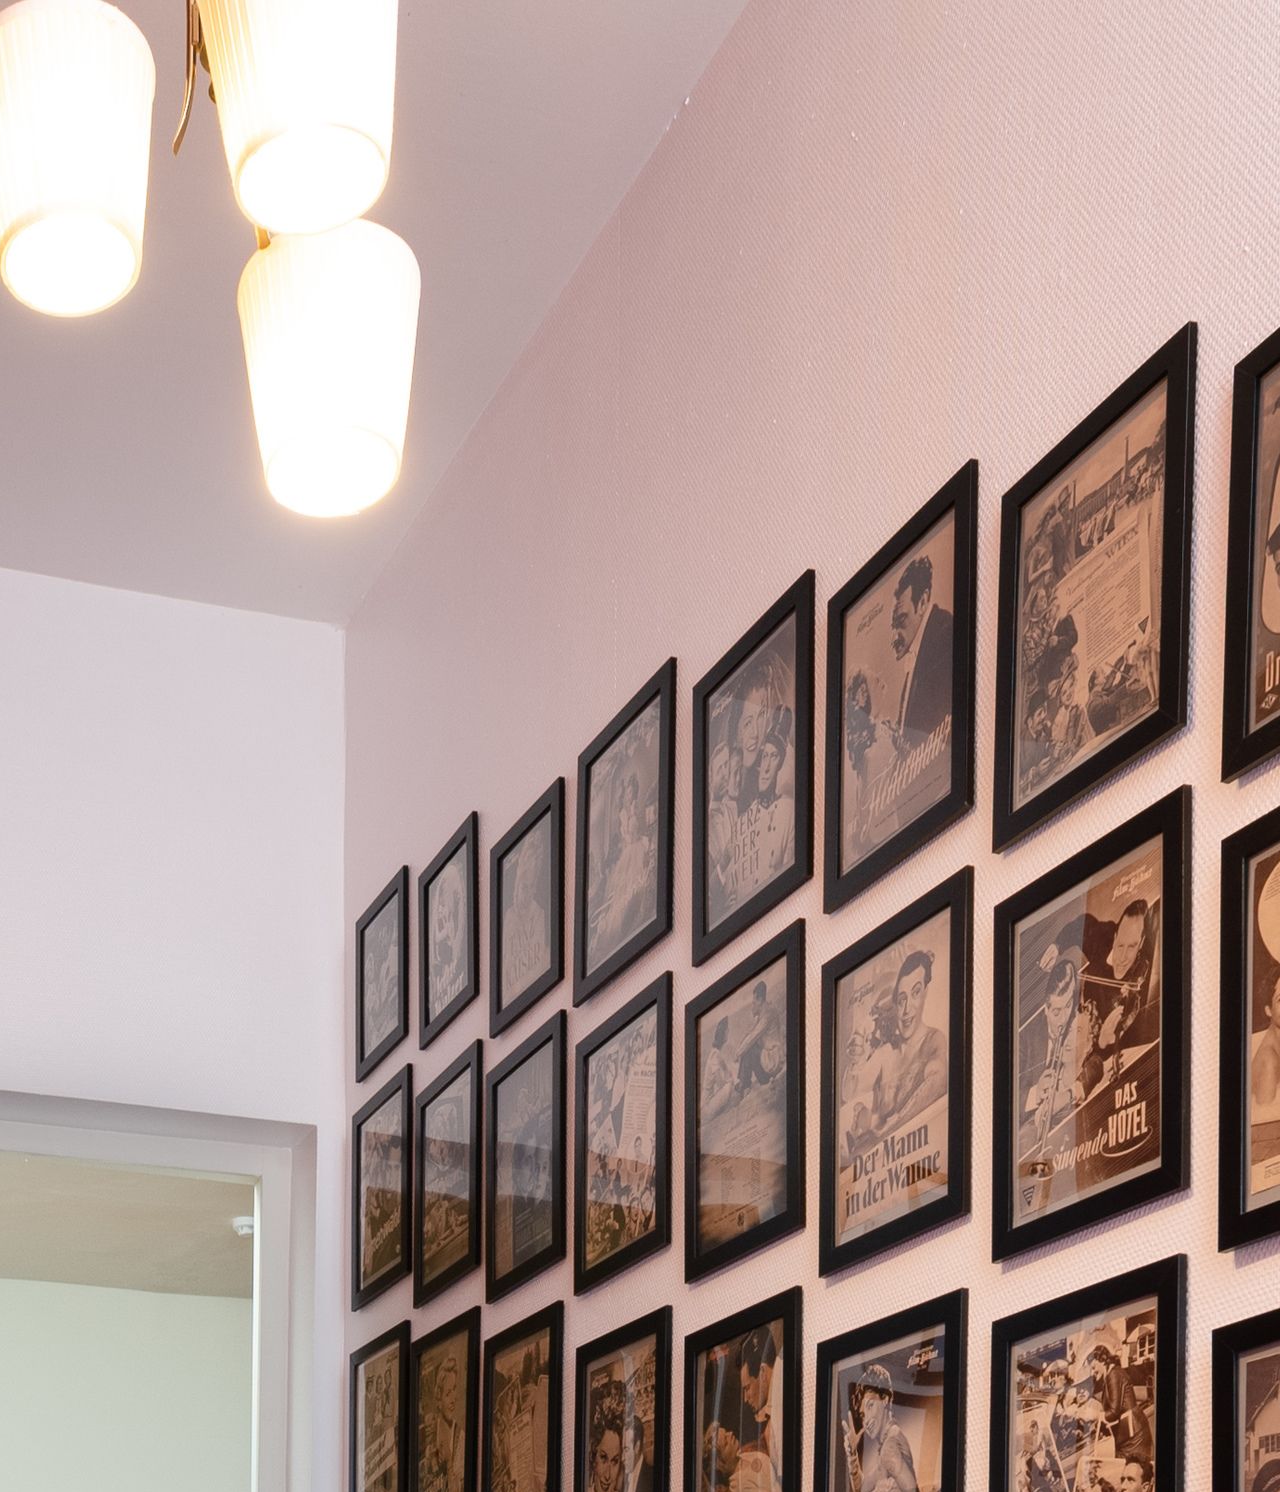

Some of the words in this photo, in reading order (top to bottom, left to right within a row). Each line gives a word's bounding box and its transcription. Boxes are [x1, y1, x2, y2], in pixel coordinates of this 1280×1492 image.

[1115, 1081, 1138, 1109] DAS
[852, 1147, 879, 1183] Der
[882, 1124, 929, 1168] Mann
[1052, 1127, 1109, 1172] singende
[1107, 1101, 1148, 1148] HOTEL
[846, 1191, 860, 1218] in
[863, 1177, 888, 1209] der
[887, 1150, 941, 1195] Wanne
